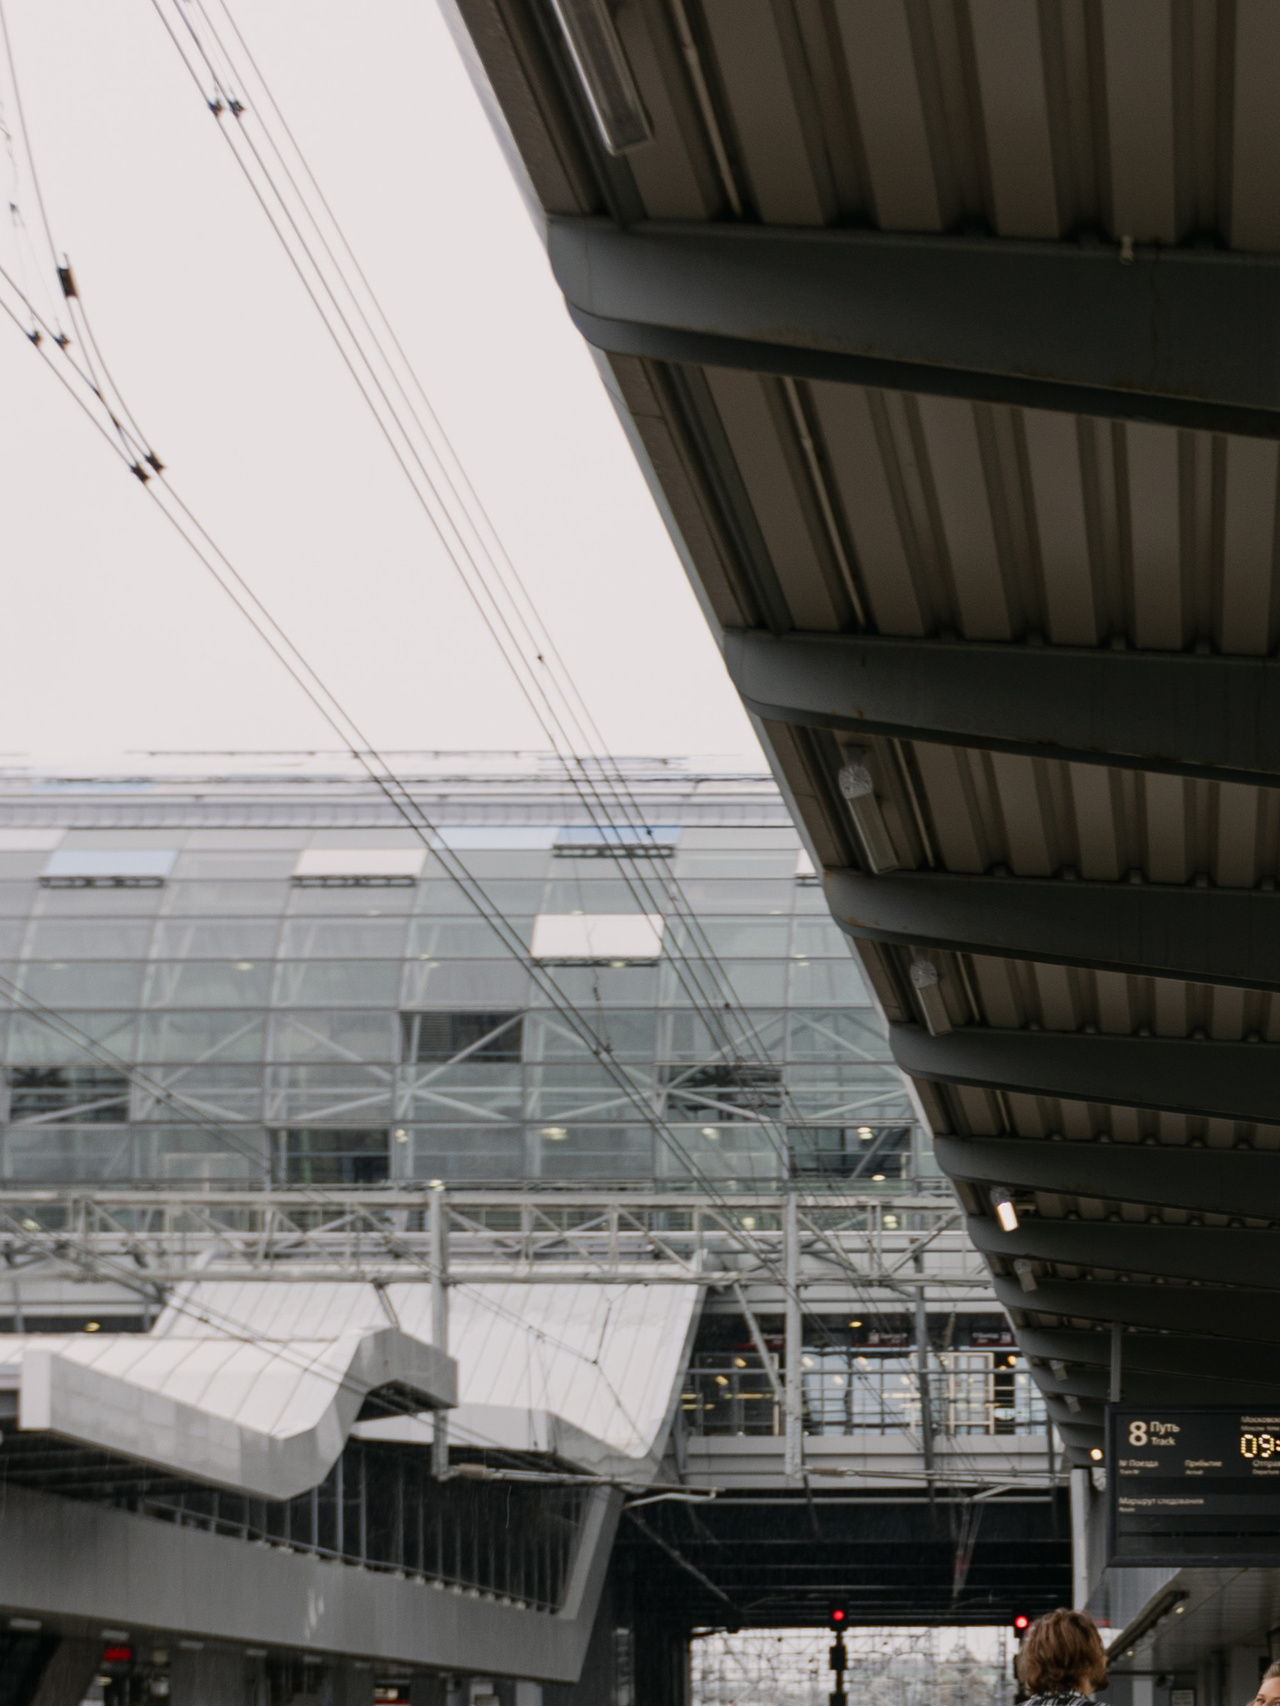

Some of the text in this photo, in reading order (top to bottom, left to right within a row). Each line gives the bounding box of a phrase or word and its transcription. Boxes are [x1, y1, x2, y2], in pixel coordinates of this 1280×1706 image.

[1128, 1420, 1147, 1447] 8
[1149, 1421, 1182, 1434] Путь
[1150, 1437, 1176, 1446] Track
